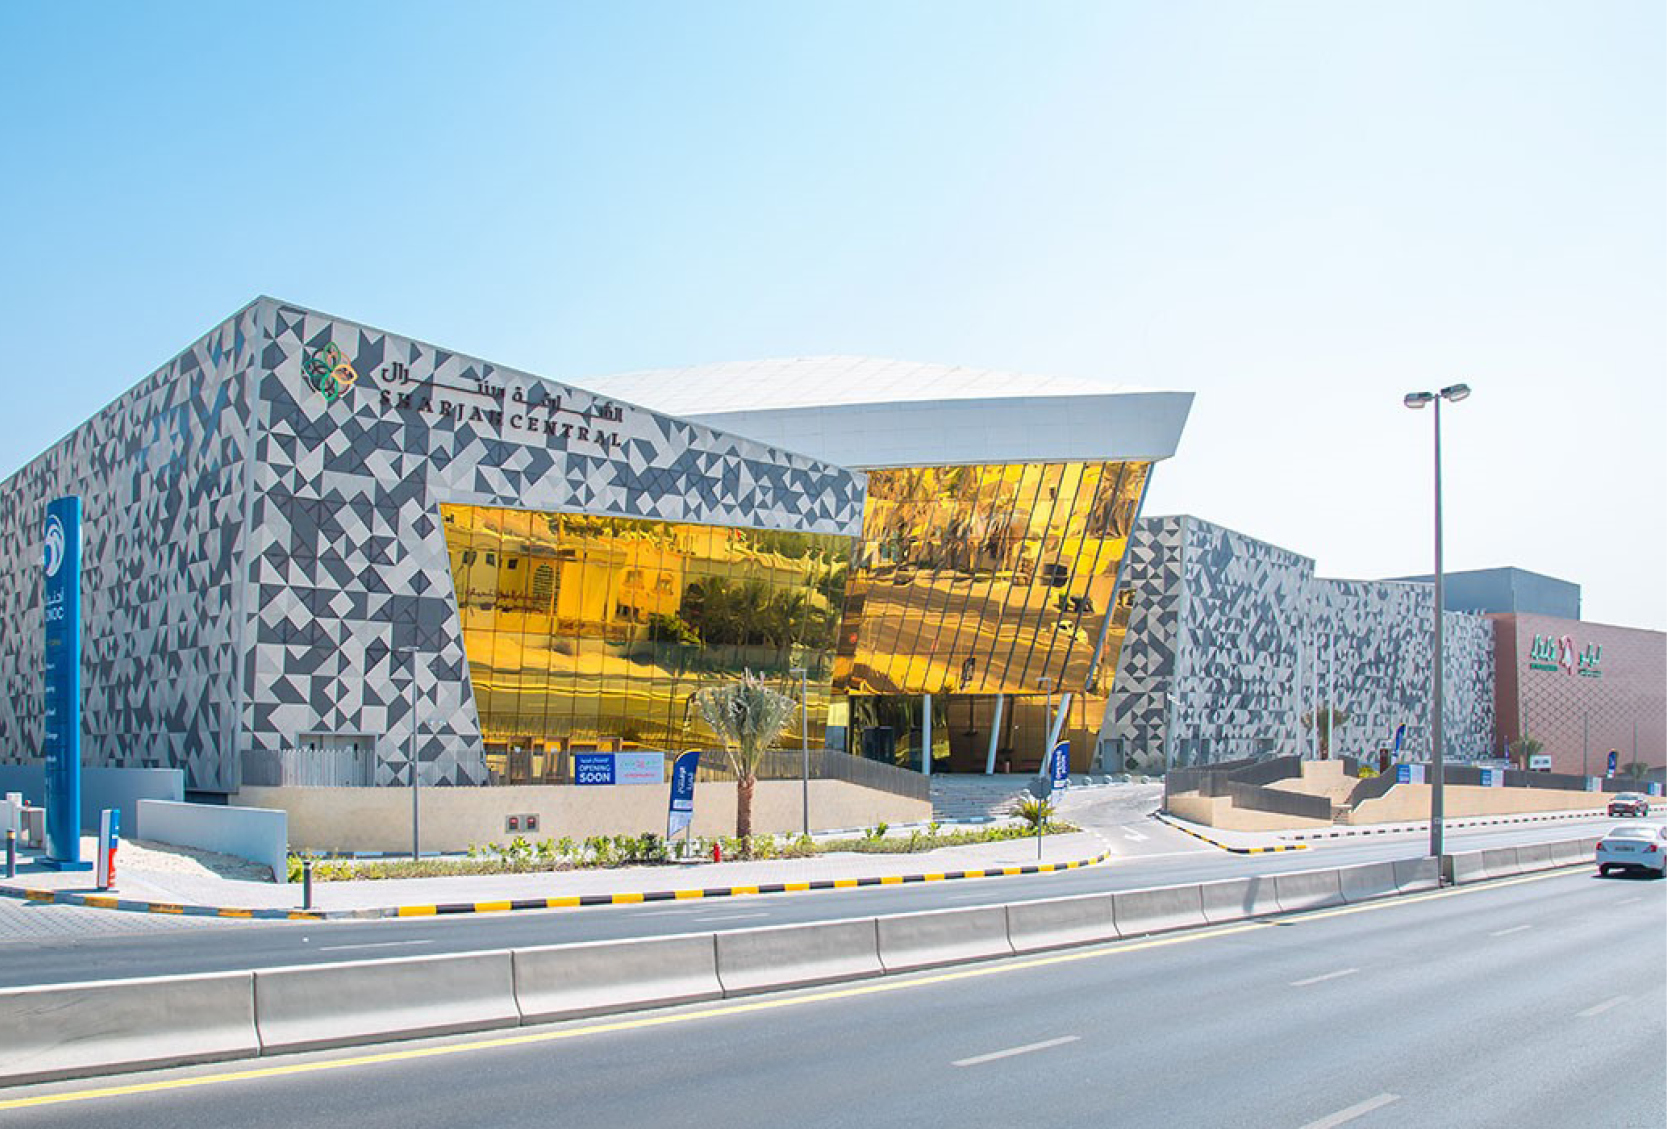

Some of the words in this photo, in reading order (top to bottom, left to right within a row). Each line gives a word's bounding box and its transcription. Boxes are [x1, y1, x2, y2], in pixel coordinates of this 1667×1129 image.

[380, 389, 502, 427] SHARJAH
[509, 413, 621, 447] CENTRAL
[578, 764, 611, 772] OPENING
[579, 772, 611, 783] SOON
